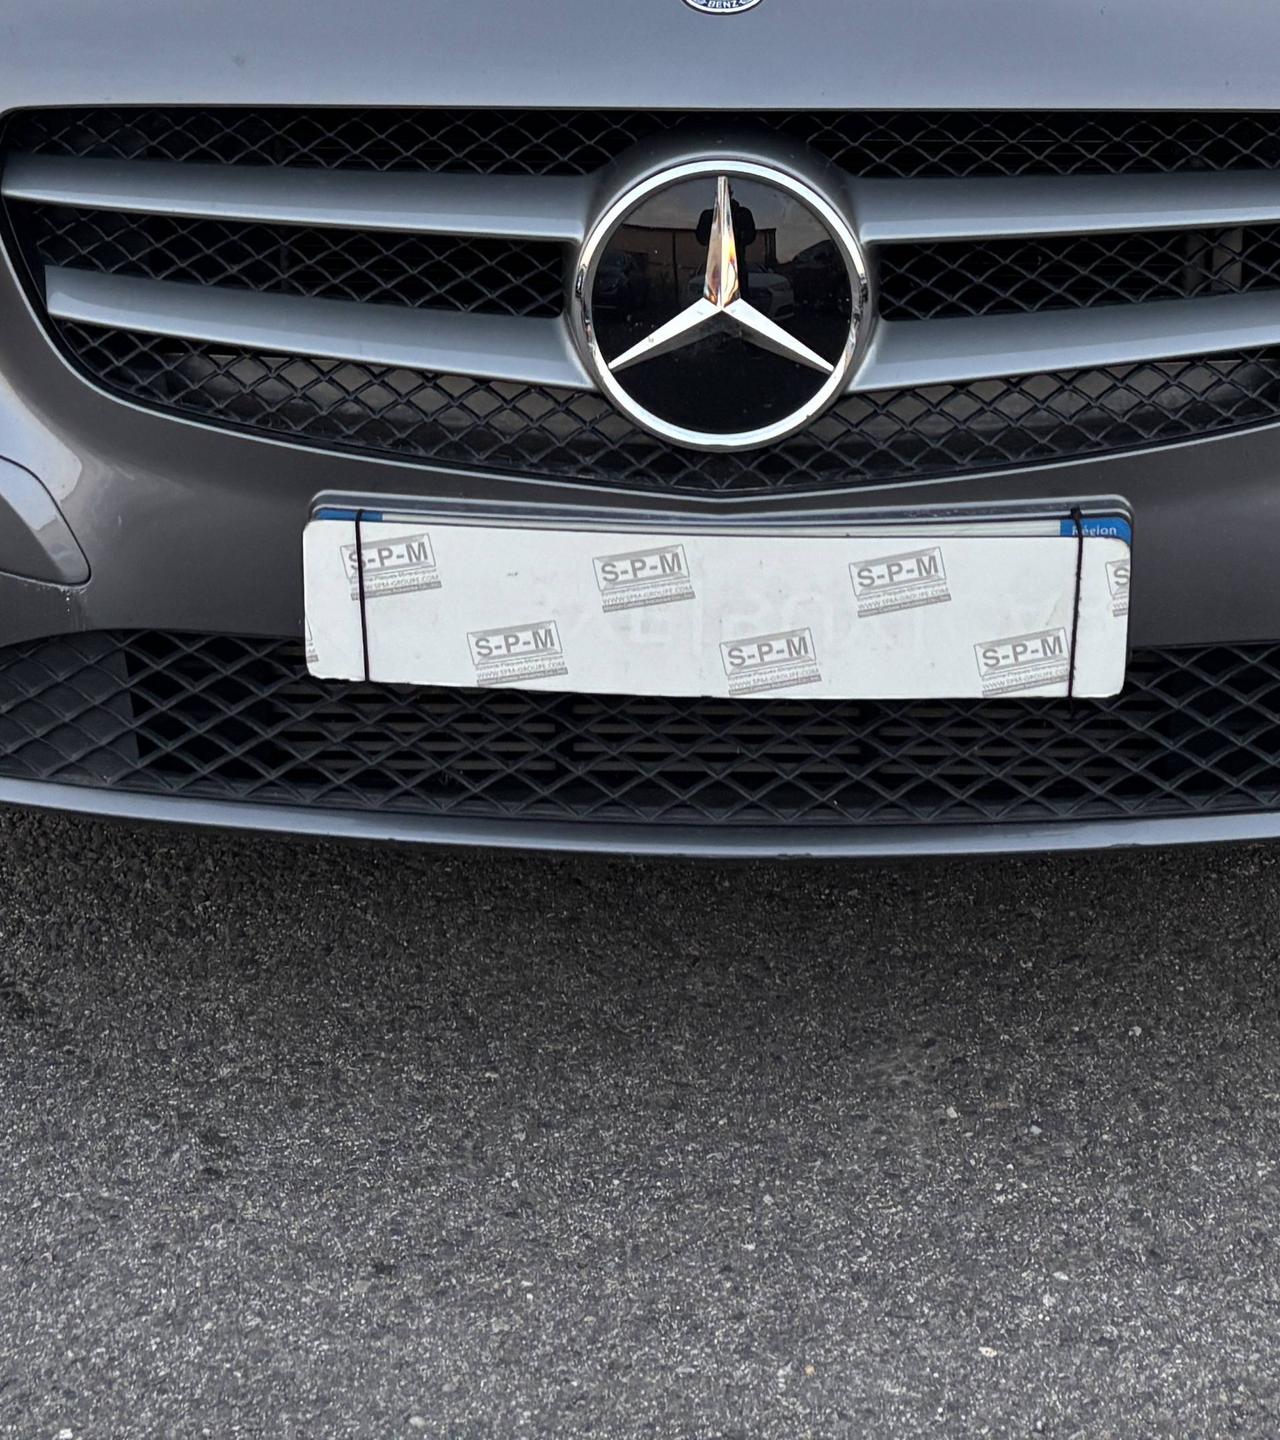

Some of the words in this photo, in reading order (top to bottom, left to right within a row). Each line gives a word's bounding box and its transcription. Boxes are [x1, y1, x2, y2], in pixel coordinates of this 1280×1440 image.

[707, 0, 739, 8] BENZ
[601, 552, 682, 582] S-P-M
[857, 555, 939, 587] S-P-M
[475, 628, 555, 657] S-P-M
[728, 636, 809, 667] S-P-M
[982, 636, 1063, 667] S-P-M
